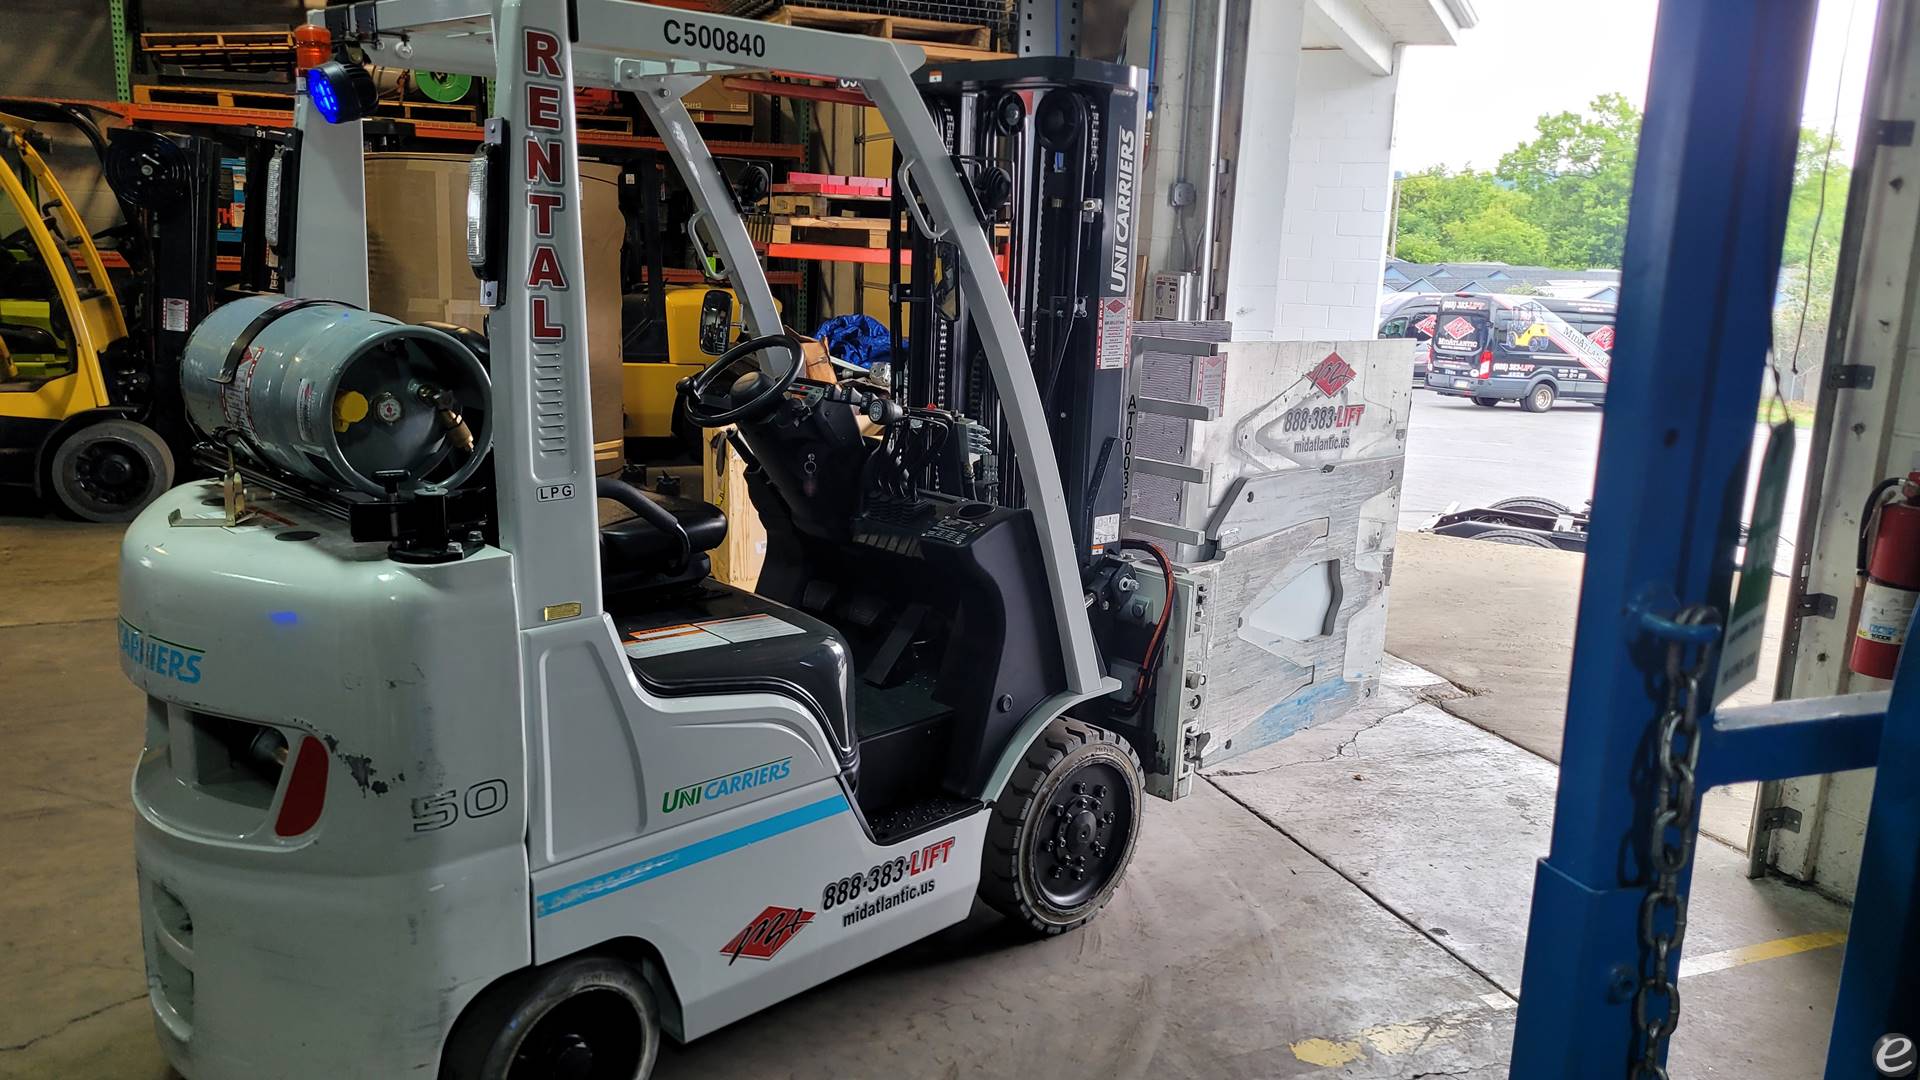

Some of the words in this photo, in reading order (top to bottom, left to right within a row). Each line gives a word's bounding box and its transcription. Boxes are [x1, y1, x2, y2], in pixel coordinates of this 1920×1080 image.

[663, 18, 766, 58] C500840
[522, 26, 569, 343] RENTAL
[1293, 434, 1350, 453] midatlantic.us
[540, 485, 572, 500] LPG
[410, 778, 508, 833] 50
[842, 879, 936, 928] midatlantic.us
